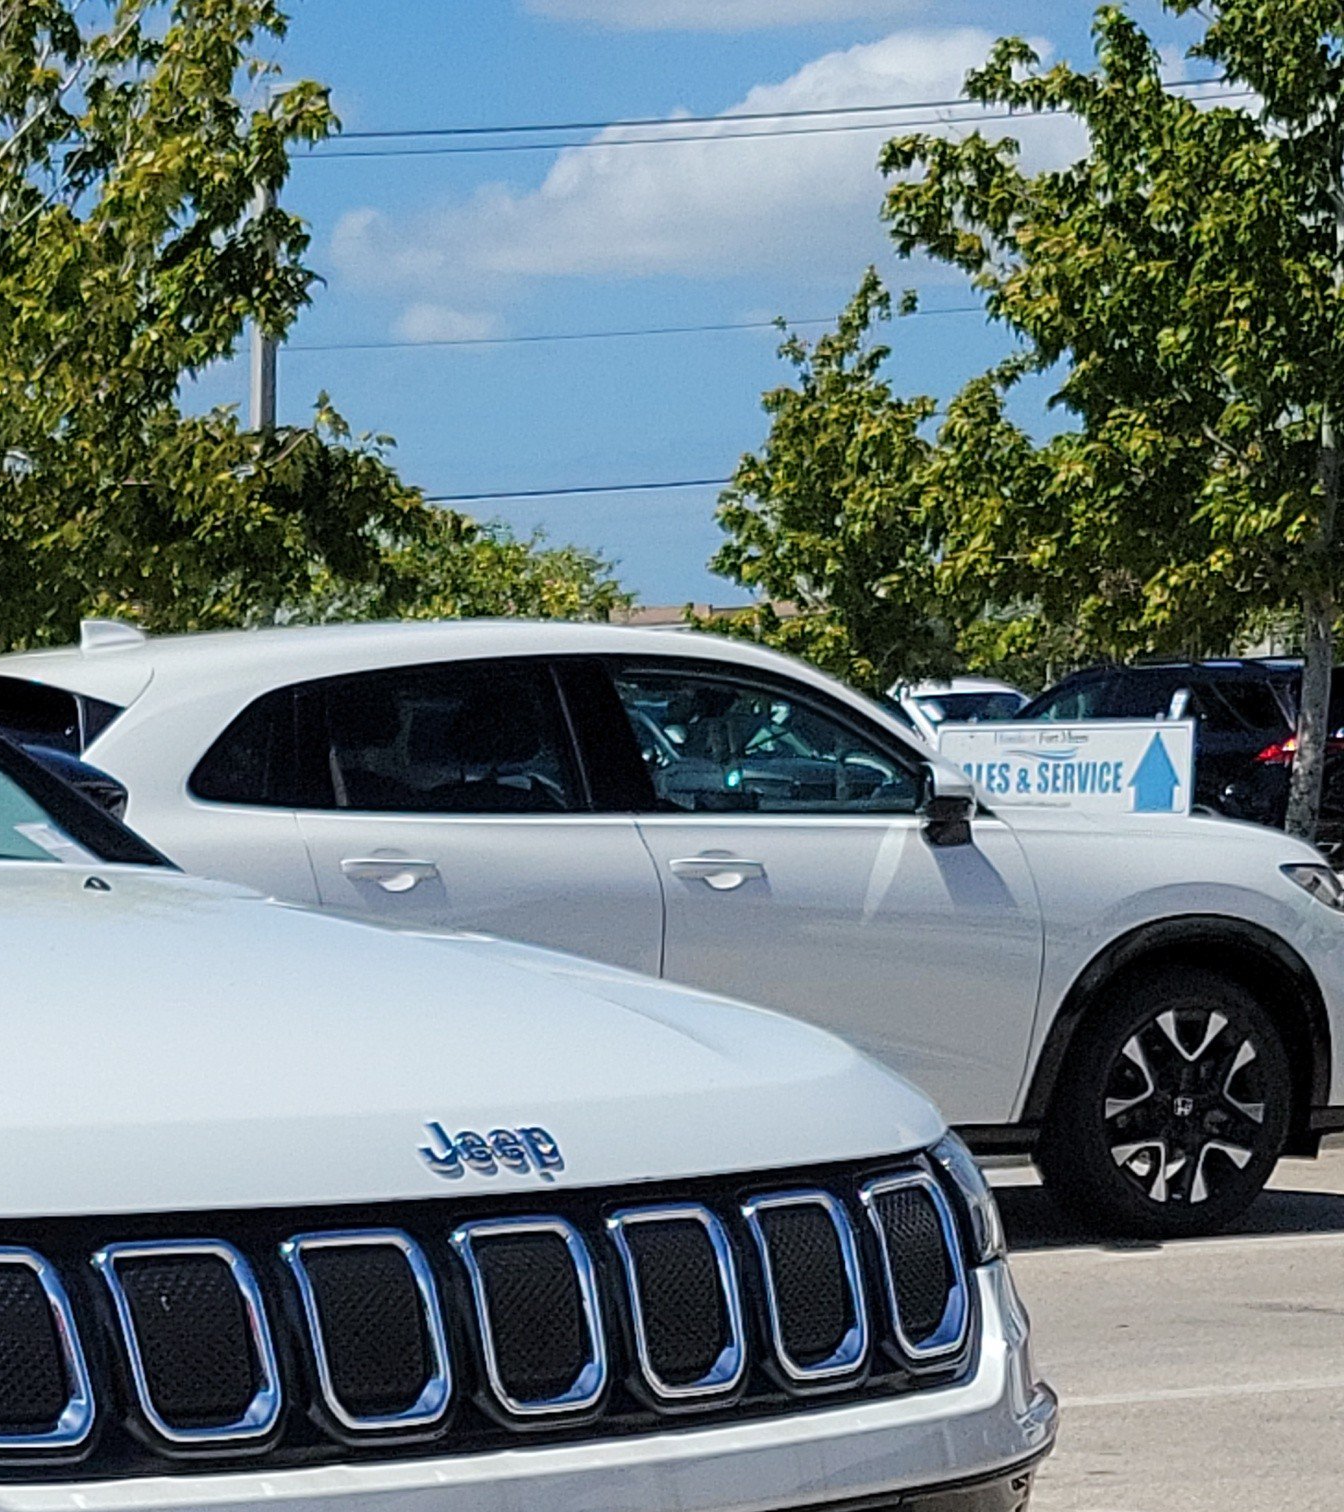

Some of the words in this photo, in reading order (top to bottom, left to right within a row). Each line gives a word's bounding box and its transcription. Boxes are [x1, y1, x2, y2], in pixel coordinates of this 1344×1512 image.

[1015, 766, 1030, 794] &
[1037, 762, 1123, 793] SERVICE
[418, 1120, 562, 1172] Jeep
